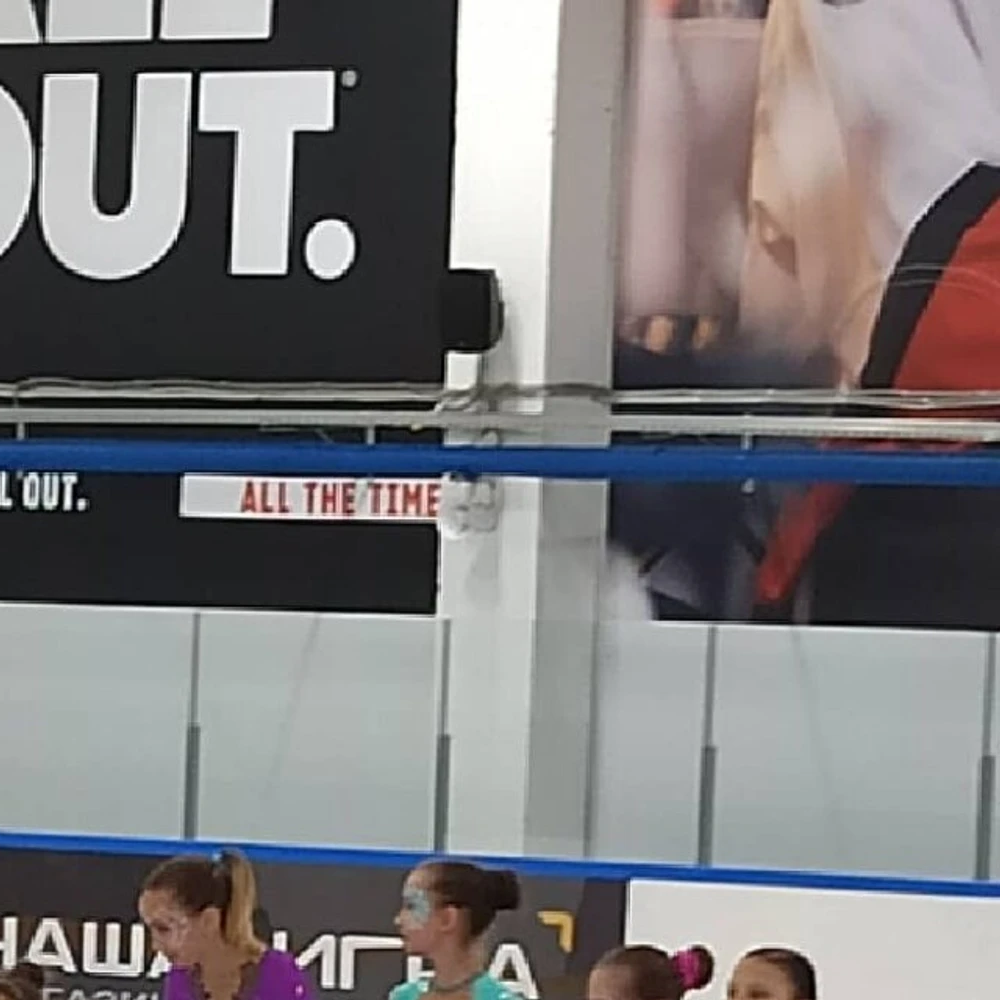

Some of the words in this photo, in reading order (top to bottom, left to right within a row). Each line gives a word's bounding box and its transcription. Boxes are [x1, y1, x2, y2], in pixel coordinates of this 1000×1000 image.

[21, 473, 89, 511] OUT.
[240, 481, 290, 513] ALL
[303, 482, 356, 514] THE
[367, 483, 441, 517] TIME
